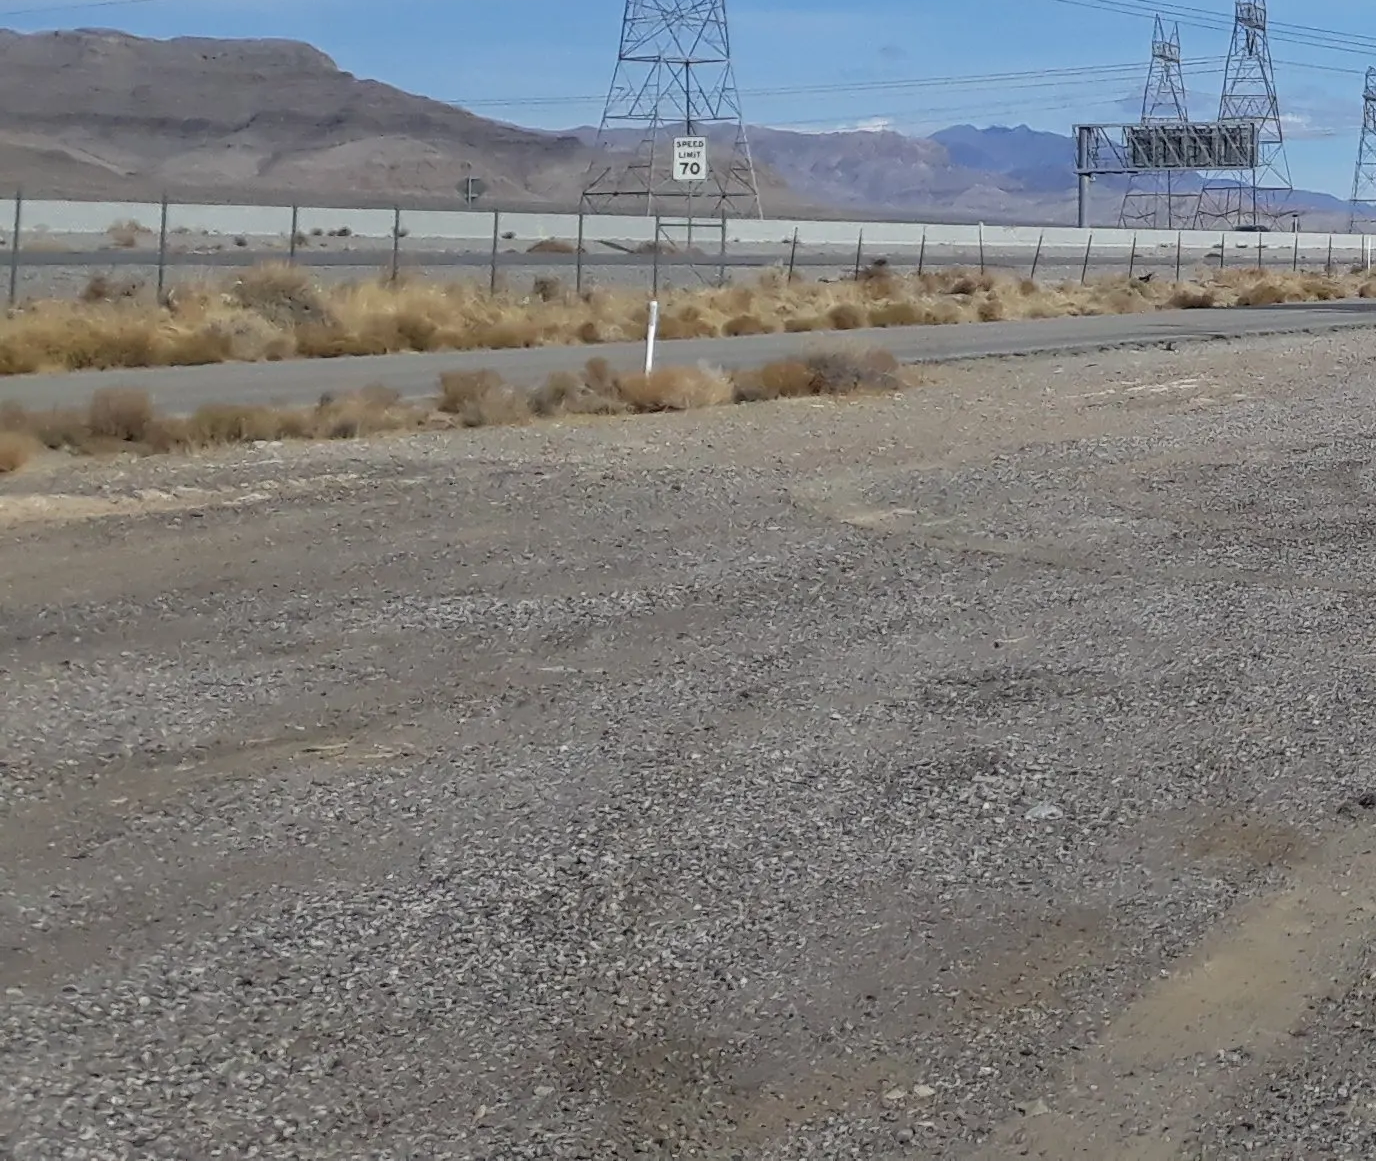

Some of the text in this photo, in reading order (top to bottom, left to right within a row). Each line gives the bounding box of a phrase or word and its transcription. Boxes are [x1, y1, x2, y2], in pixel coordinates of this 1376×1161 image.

[676, 140, 705, 148] SPEED
[678, 151, 701, 159] LIMIT
[679, 162, 701, 175] 70
